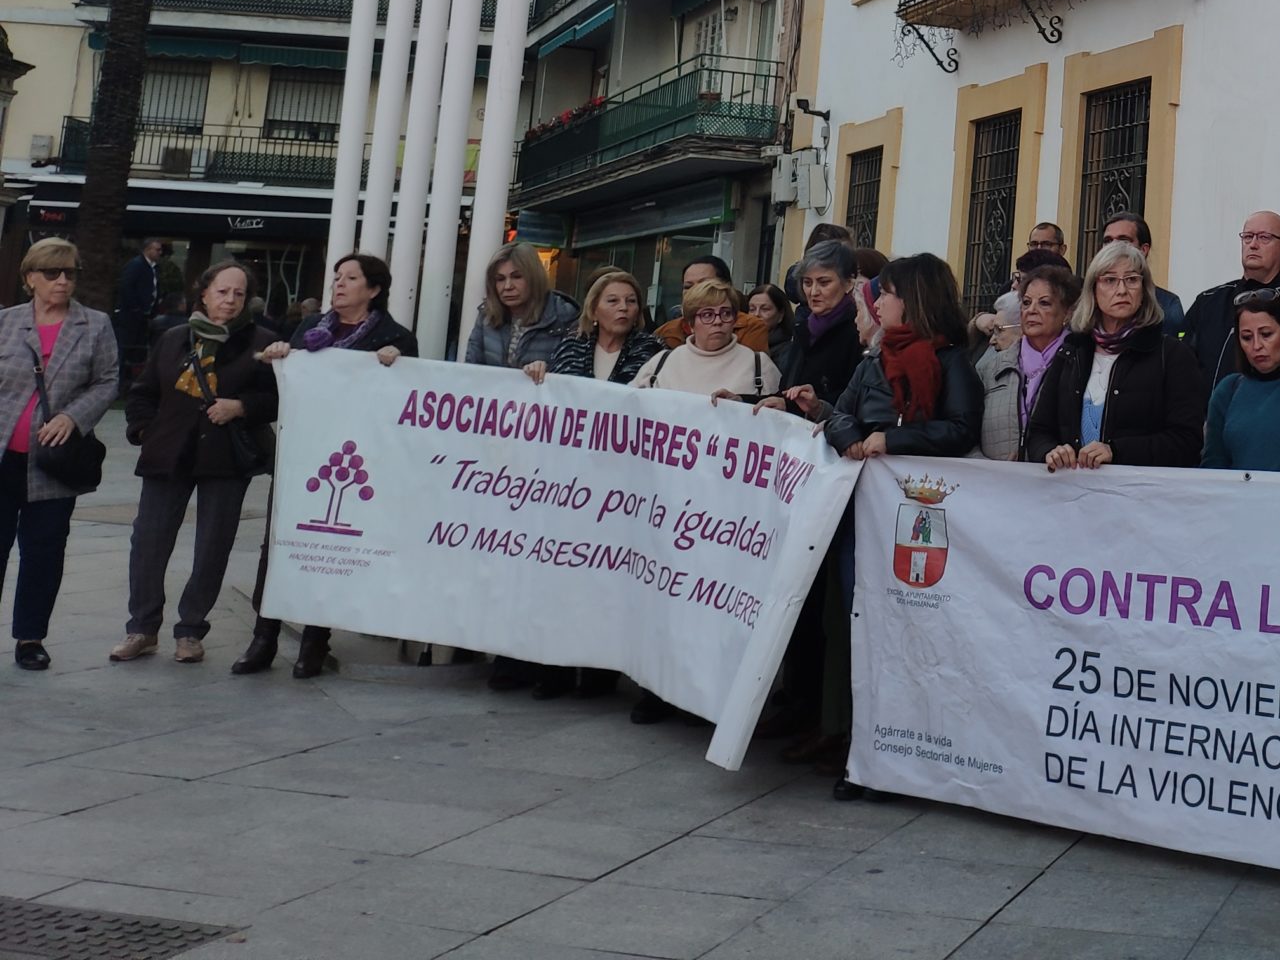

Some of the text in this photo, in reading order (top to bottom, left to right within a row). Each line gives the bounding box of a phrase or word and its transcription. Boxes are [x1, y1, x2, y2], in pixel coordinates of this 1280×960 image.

[398, 390, 557, 444] ASOCIACION
[559, 407, 587, 448] DE
[588, 411, 701, 471] MUJERES
[743, 441, 775, 488] DE
[597, 489, 646, 523] por
[649, 494, 666, 529] la
[427, 521, 469, 547] NO
[471, 527, 527, 557] MAS
[526, 536, 657, 585] ASESINATOS
[657, 566, 689, 597] DE
[1023, 564, 1241, 631] CONTRA
[1052, 647, 1101, 694] 25
[1113, 666, 1156, 702] DE
[874, 724, 952, 747] Agárrate a la vida
[1045, 701, 1101, 743] DÍA
[874, 740, 1003, 774] Consejo Sectorial de Mujeres
[1044, 752, 1086, 789] DE
[1097, 760, 1138, 798] LA
